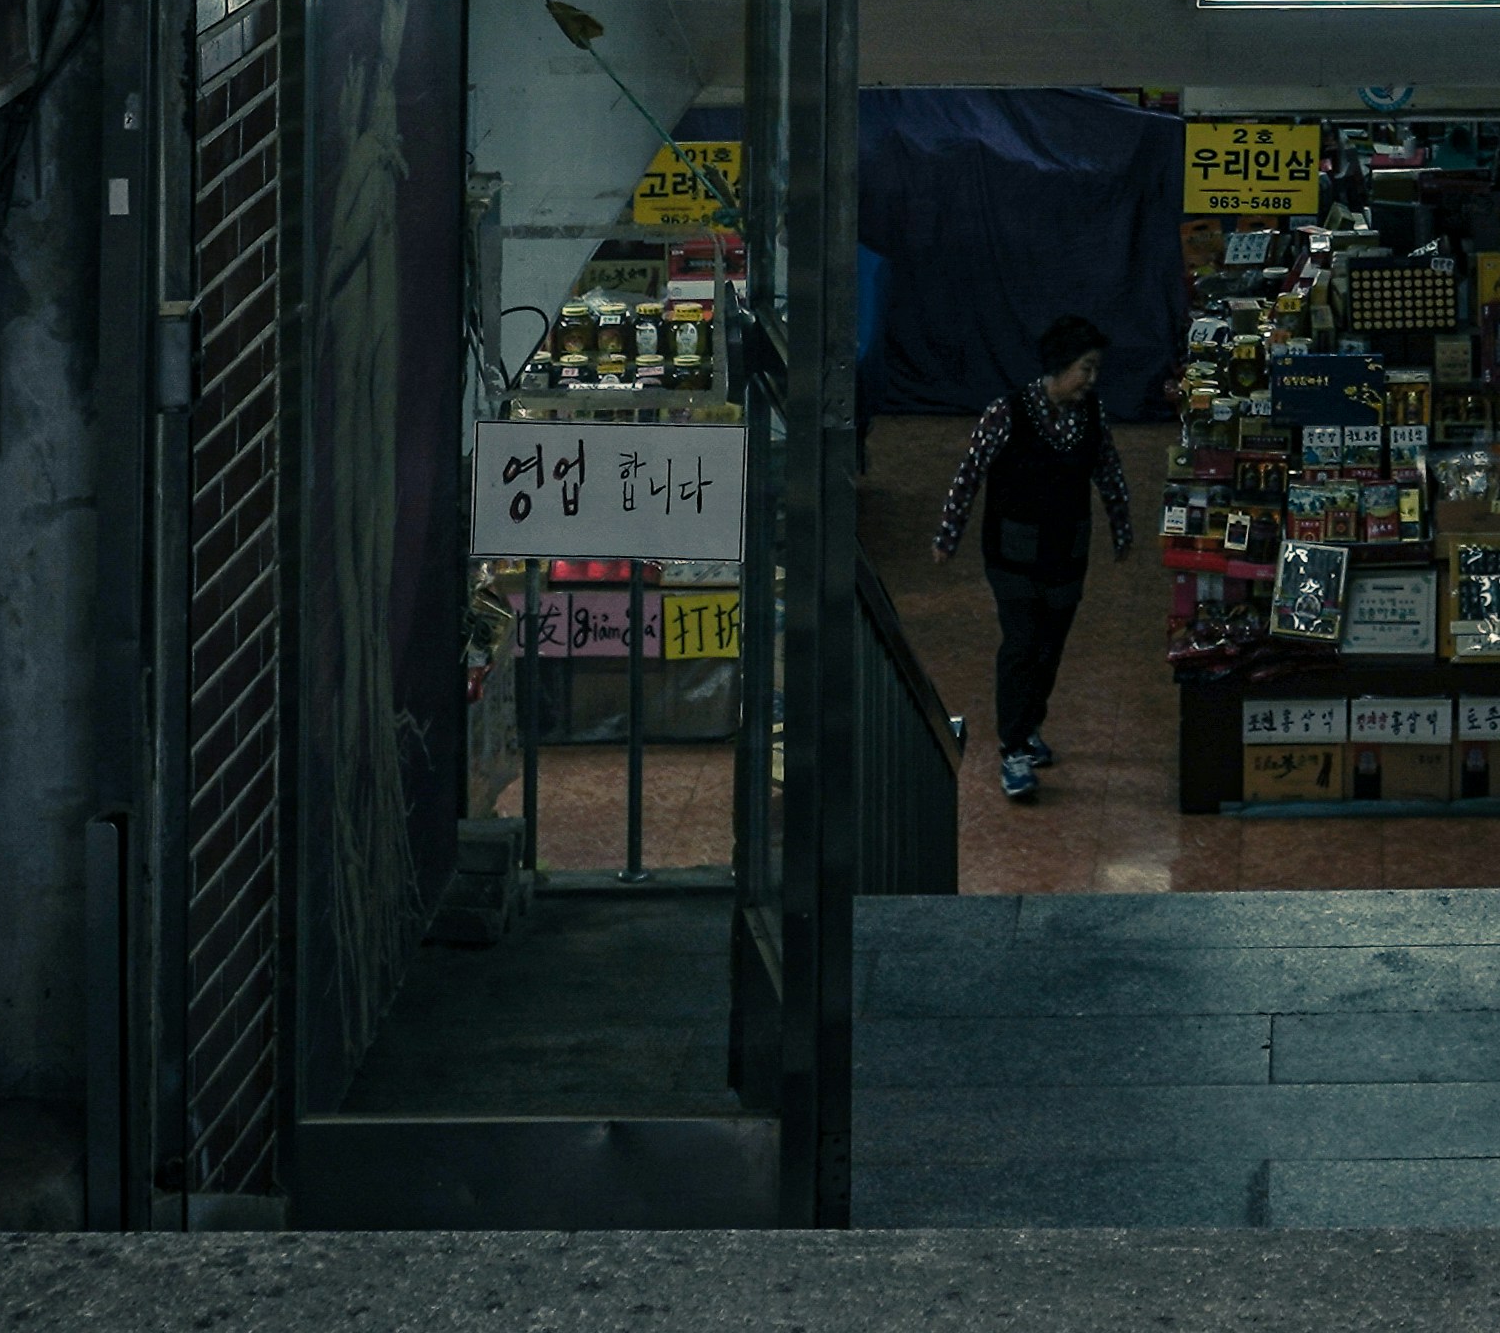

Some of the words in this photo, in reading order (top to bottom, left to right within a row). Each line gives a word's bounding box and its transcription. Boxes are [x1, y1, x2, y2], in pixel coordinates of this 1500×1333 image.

[1191, 148, 1314, 182] 우리인삼
[1209, 196, 1292, 211] 963-5488
[502, 438, 586, 524] 영업
[618, 451, 714, 515] 합니다
